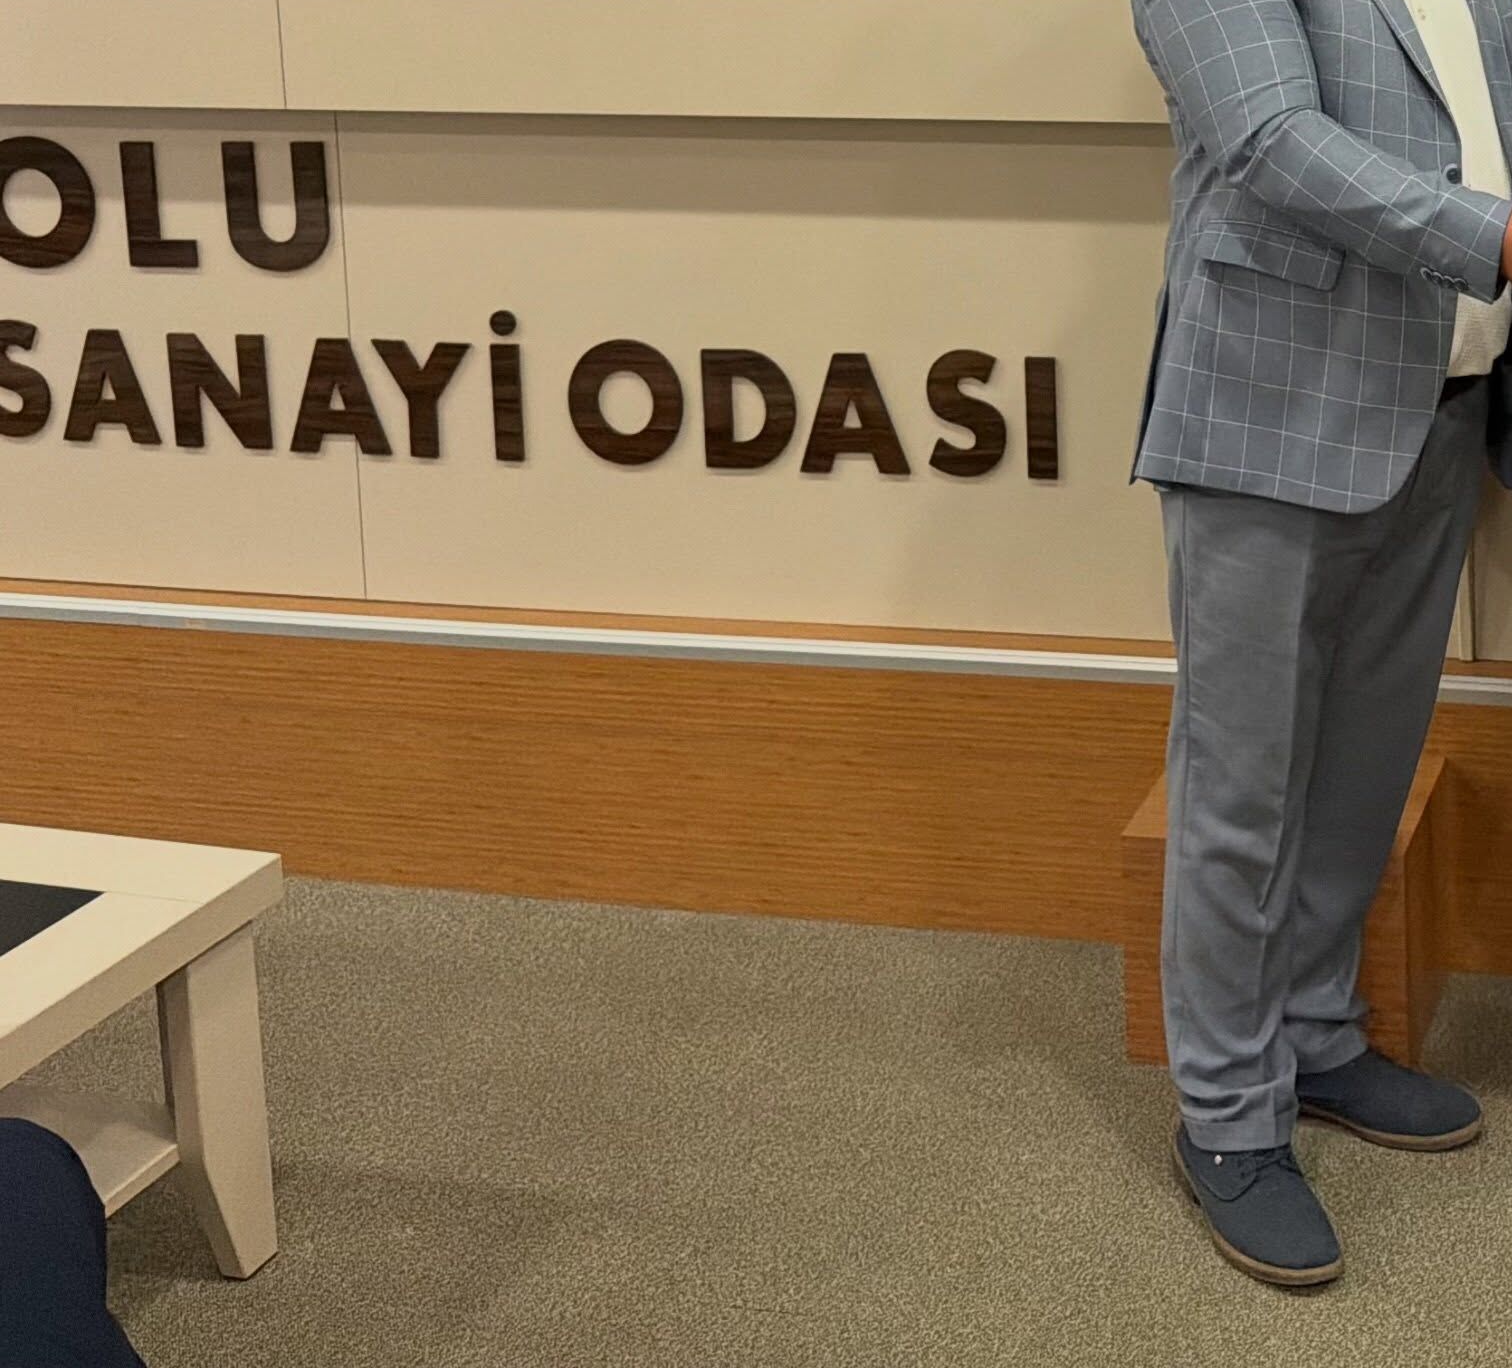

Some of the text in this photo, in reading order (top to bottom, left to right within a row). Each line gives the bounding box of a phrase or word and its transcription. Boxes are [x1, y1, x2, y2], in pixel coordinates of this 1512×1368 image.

[0, 134, 331, 272] OLU
[0, 309, 1060, 480] SANAYİ ODASI
